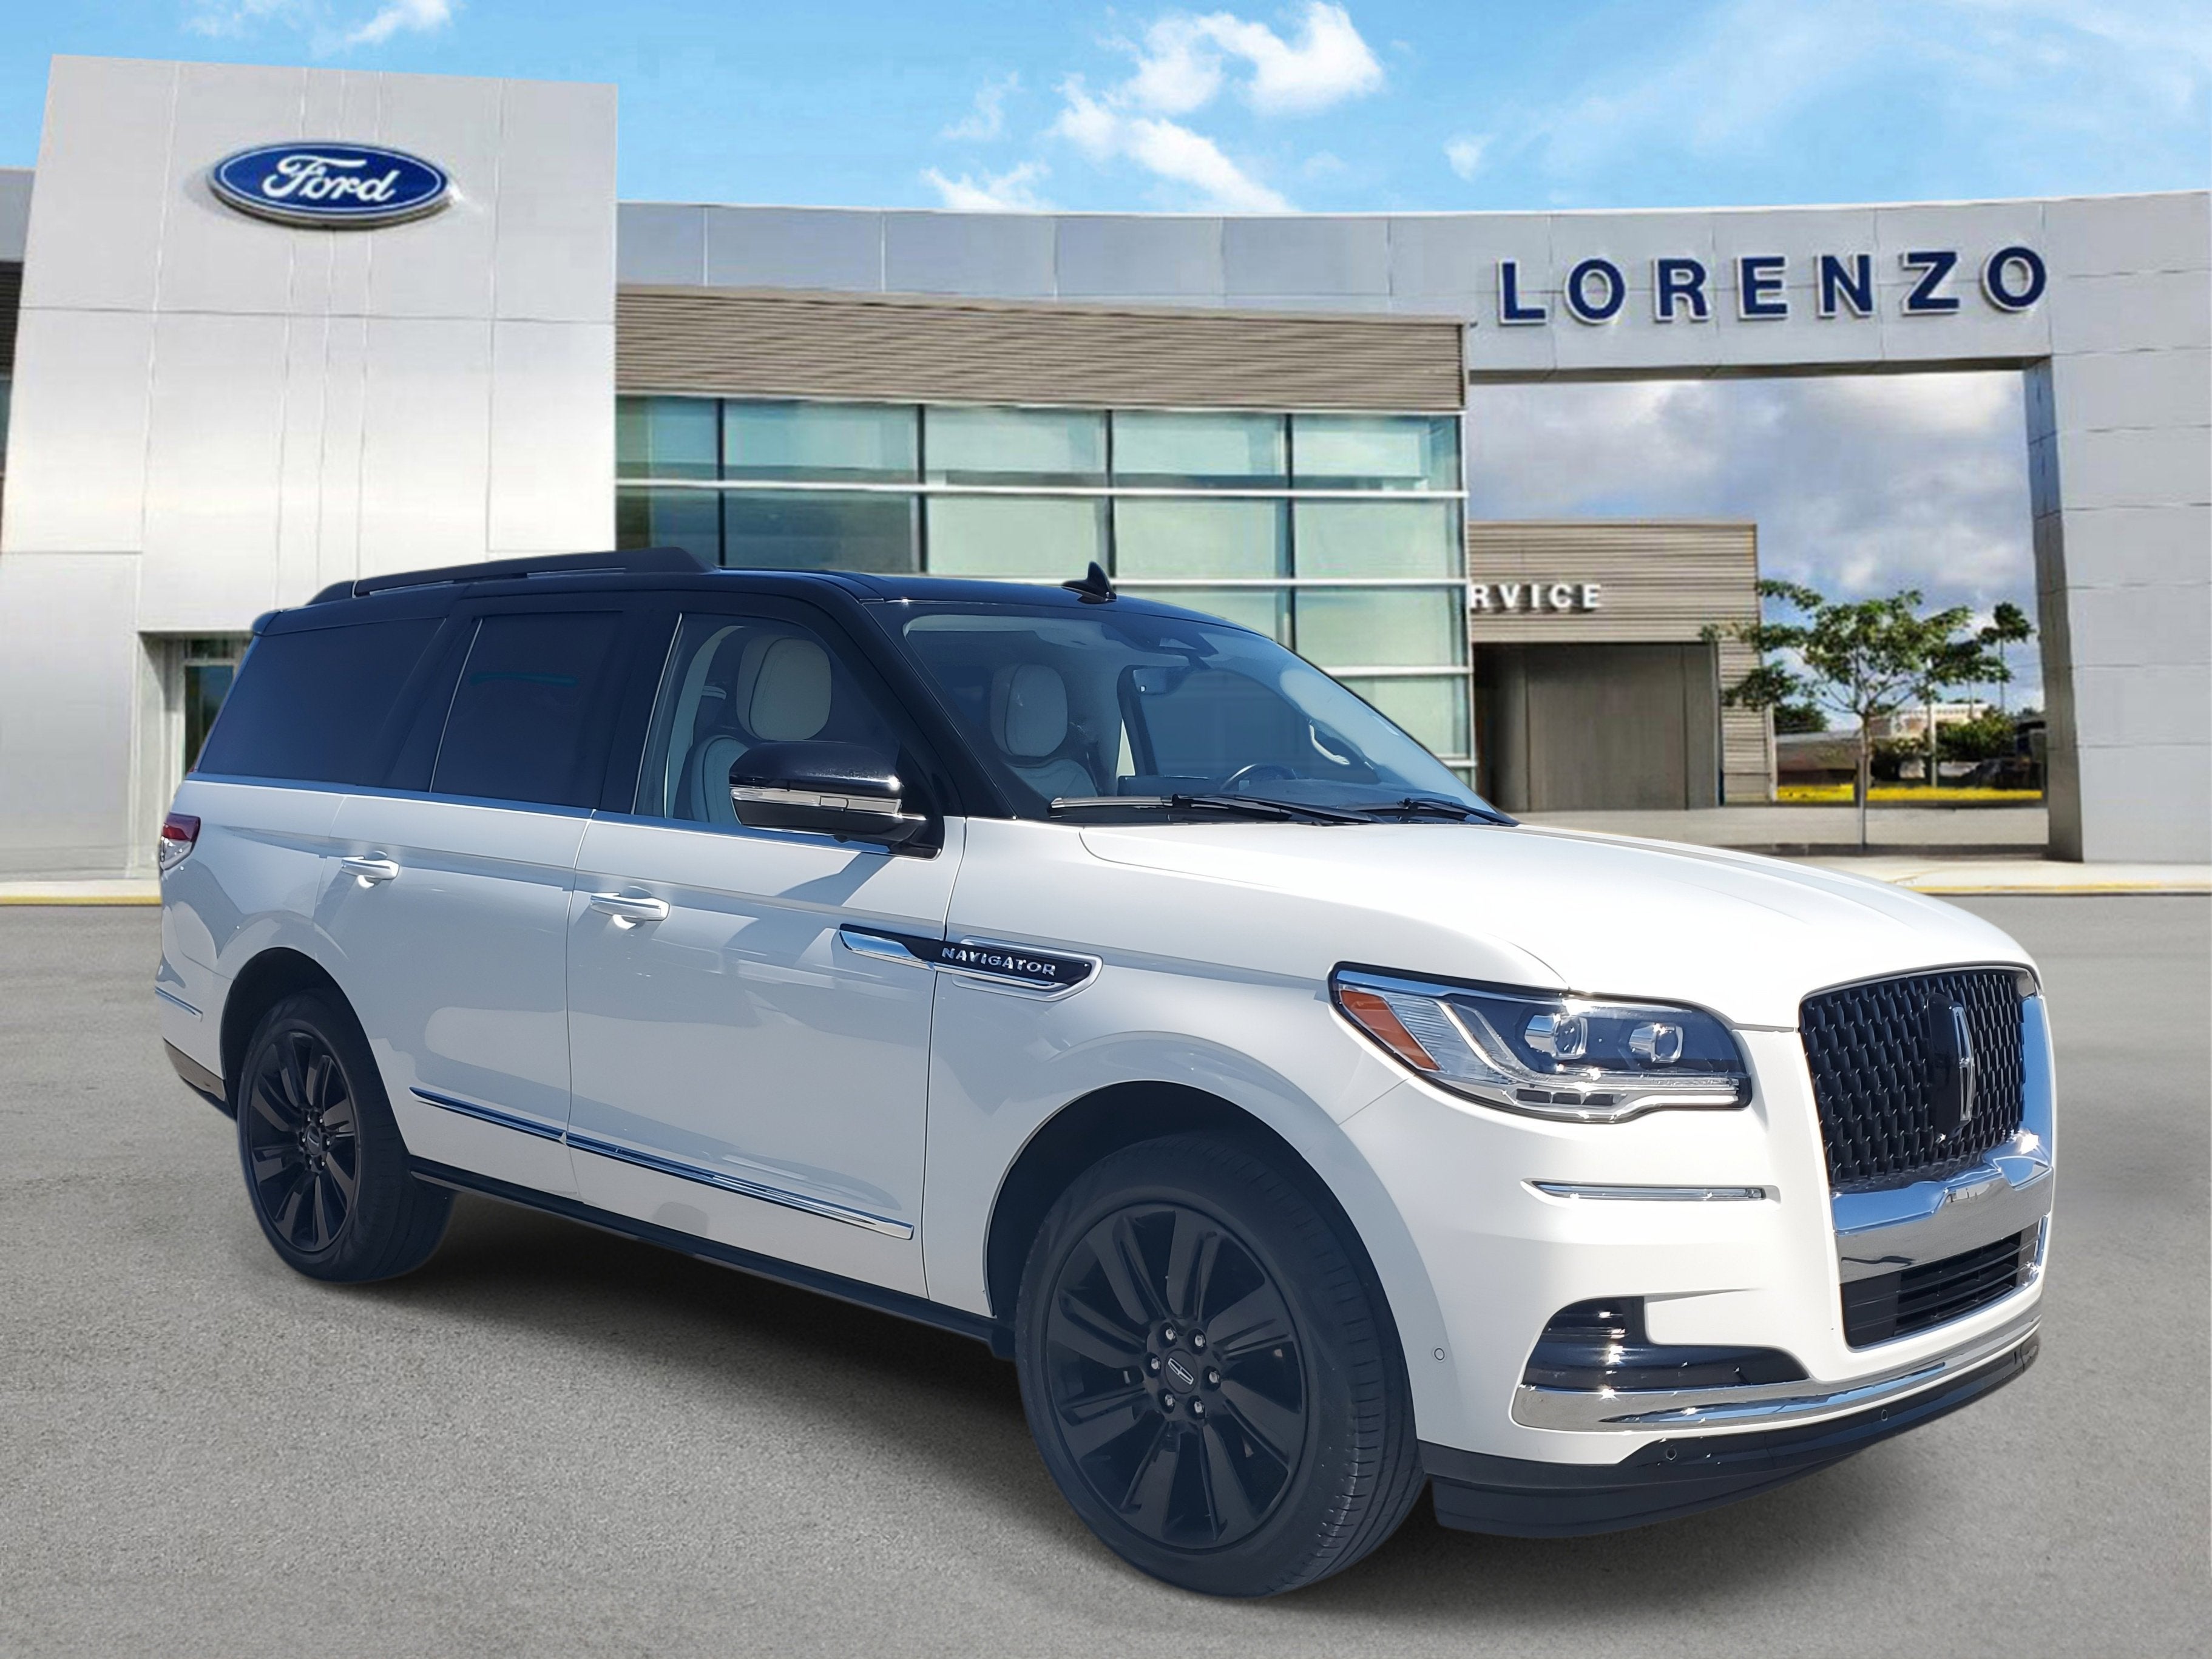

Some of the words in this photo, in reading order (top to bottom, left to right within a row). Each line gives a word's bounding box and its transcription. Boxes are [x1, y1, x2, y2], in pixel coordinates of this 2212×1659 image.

[262, 154, 401, 202] Ford
[1497, 246, 2048, 324] LORENZO
[1470, 583, 1602, 609] RVICE
[941, 947, 1057, 976] NAVIGATOR
